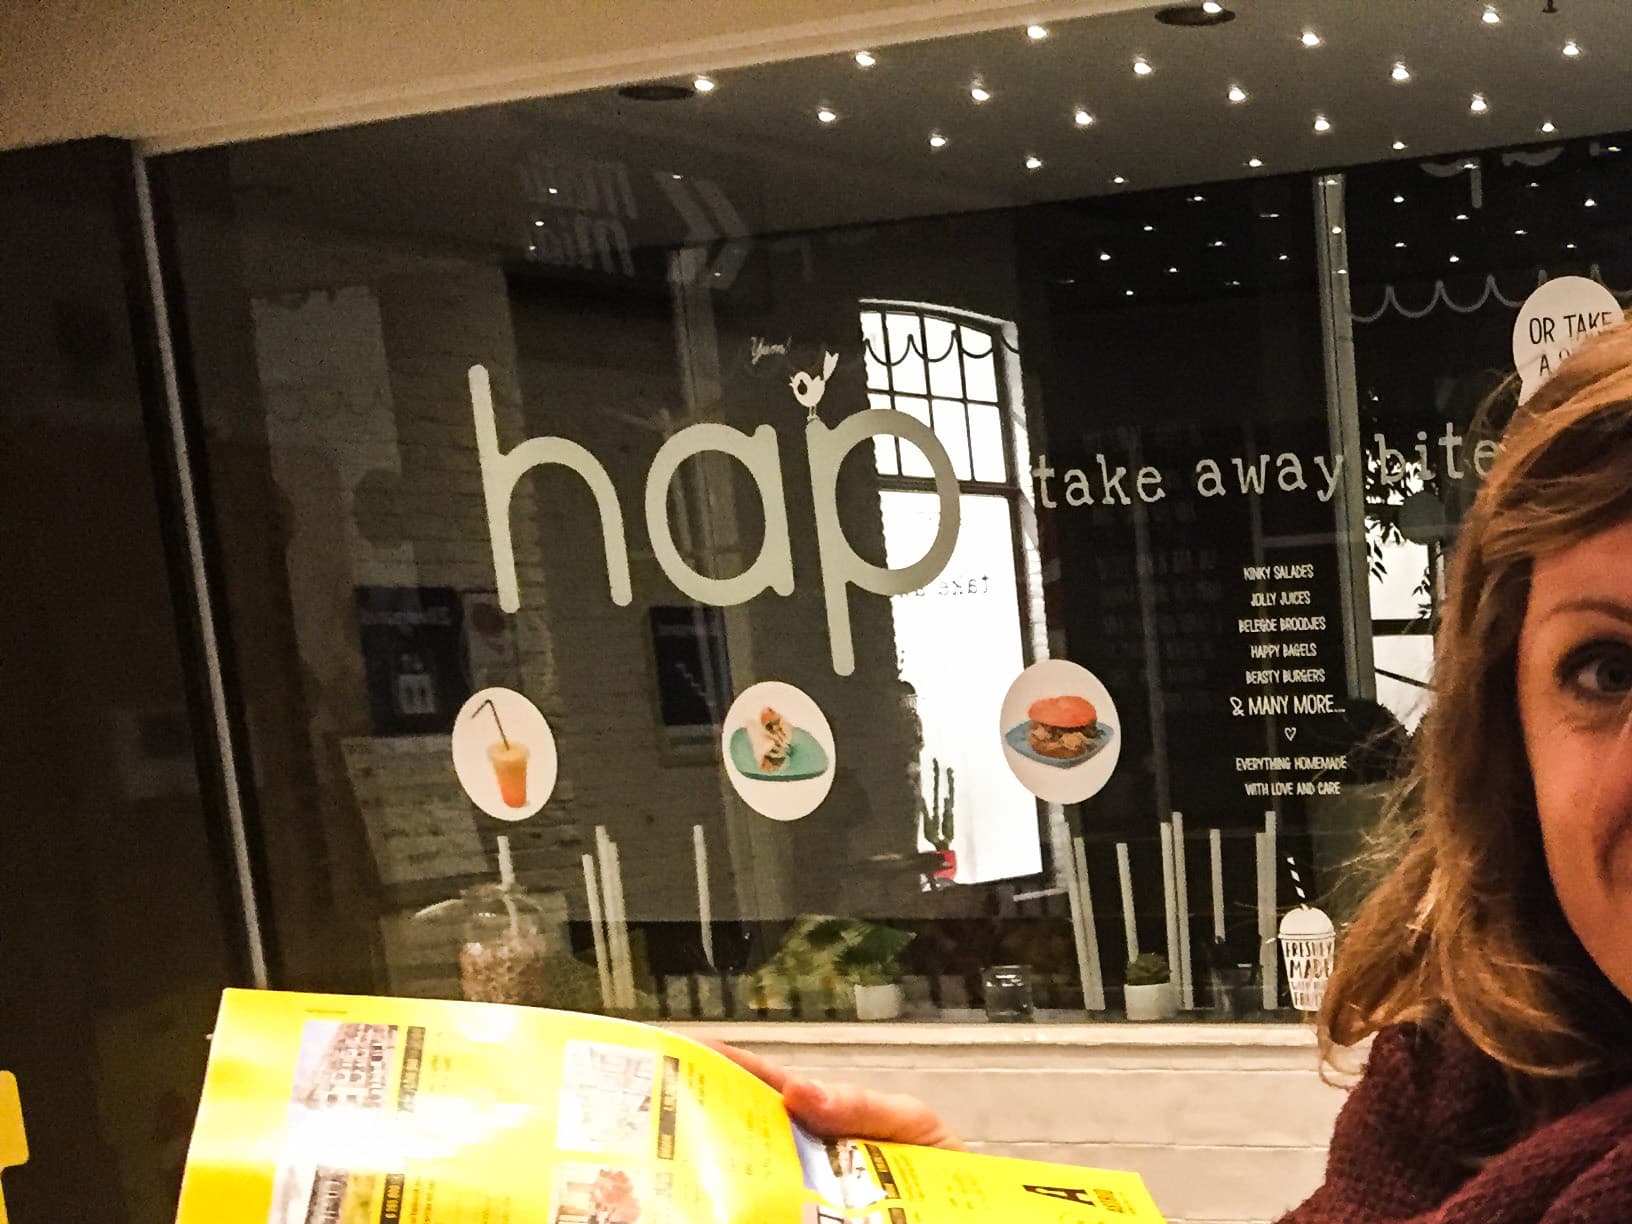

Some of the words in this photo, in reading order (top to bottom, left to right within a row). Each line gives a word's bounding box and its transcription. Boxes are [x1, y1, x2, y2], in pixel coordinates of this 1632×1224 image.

[1529, 317, 1555, 345] OR
[1539, 353, 1553, 377] A
[1033, 453, 1165, 509] take
[1197, 450, 1346, 502] away
[468, 364, 961, 677] hap
[1243, 566, 1271, 580] KINKY
[1273, 564, 1314, 580] SALADES
[1251, 592, 1277, 606] JOLLY
[1280, 591, 1311, 605] JUICES
[1251, 644, 1280, 658] HAPPY
[1282, 643, 1317, 657] BAGELS
[1245, 669, 1280, 685] BEASTY
[1282, 668, 1326, 683] BURGERS
[1230, 697, 1245, 716] &
[1248, 695, 1289, 716] MANY
[1235, 757, 1291, 771] EVERYTHING
[1294, 755, 1347, 770] HOMEMADE
[1245, 783, 1269, 796] WITH
[1271, 782, 1293, 796] LOVE
[1297, 782, 1315, 795] AND
[1318, 781, 1341, 795] CARE
